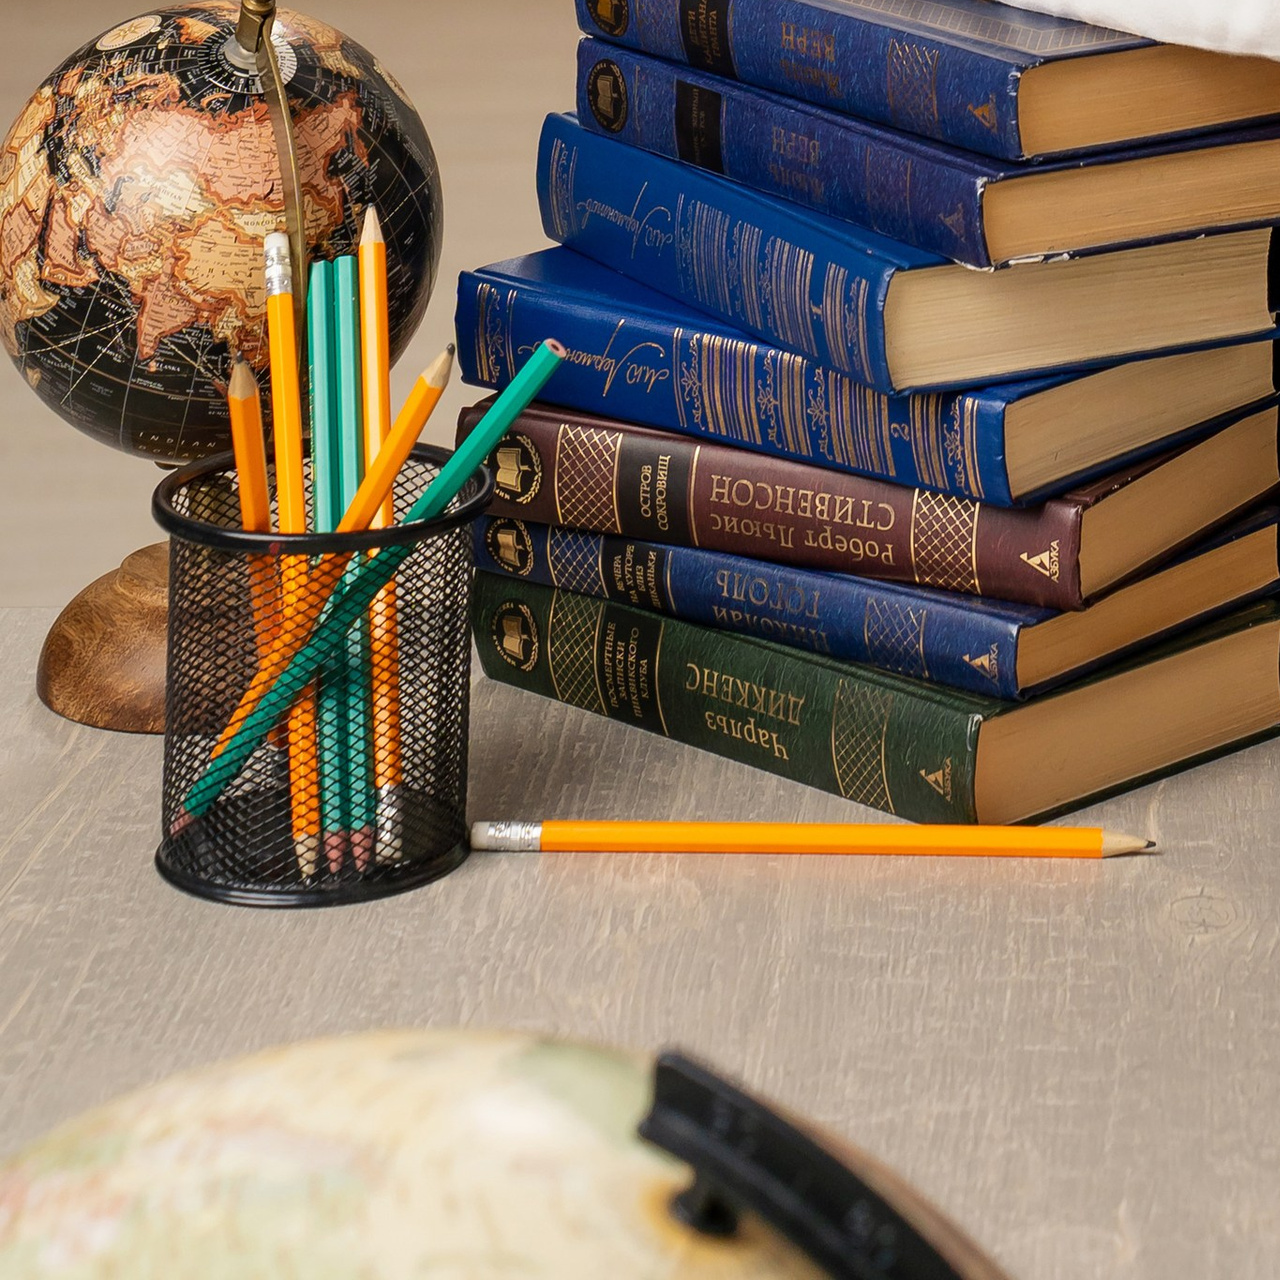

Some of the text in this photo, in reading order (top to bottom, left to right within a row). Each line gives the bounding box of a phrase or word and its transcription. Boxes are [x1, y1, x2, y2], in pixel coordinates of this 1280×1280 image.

[640, 464, 653, 519] ОСТРОВ
[656, 454, 672, 531] СОКРОВИЩ
[709, 474, 896, 532] СТИВЕНСОН
[712, 513, 897, 567] Роберт Льюис
[1050, 539, 1061, 583] АЗБУКА
[715, 568, 821, 618] ГОГОЛЬ
[604, 621, 617, 708] ПОСМЕРТНЫЕ
[615, 640, 627, 700] ЗАПИСКИ
[628, 627, 643, 719] ПИКВИКСКОГО
[640, 658, 649, 699] КЛУБА
[685, 662, 805, 726] ДИККЕНС
[704, 711, 790, 761] Чарльз
